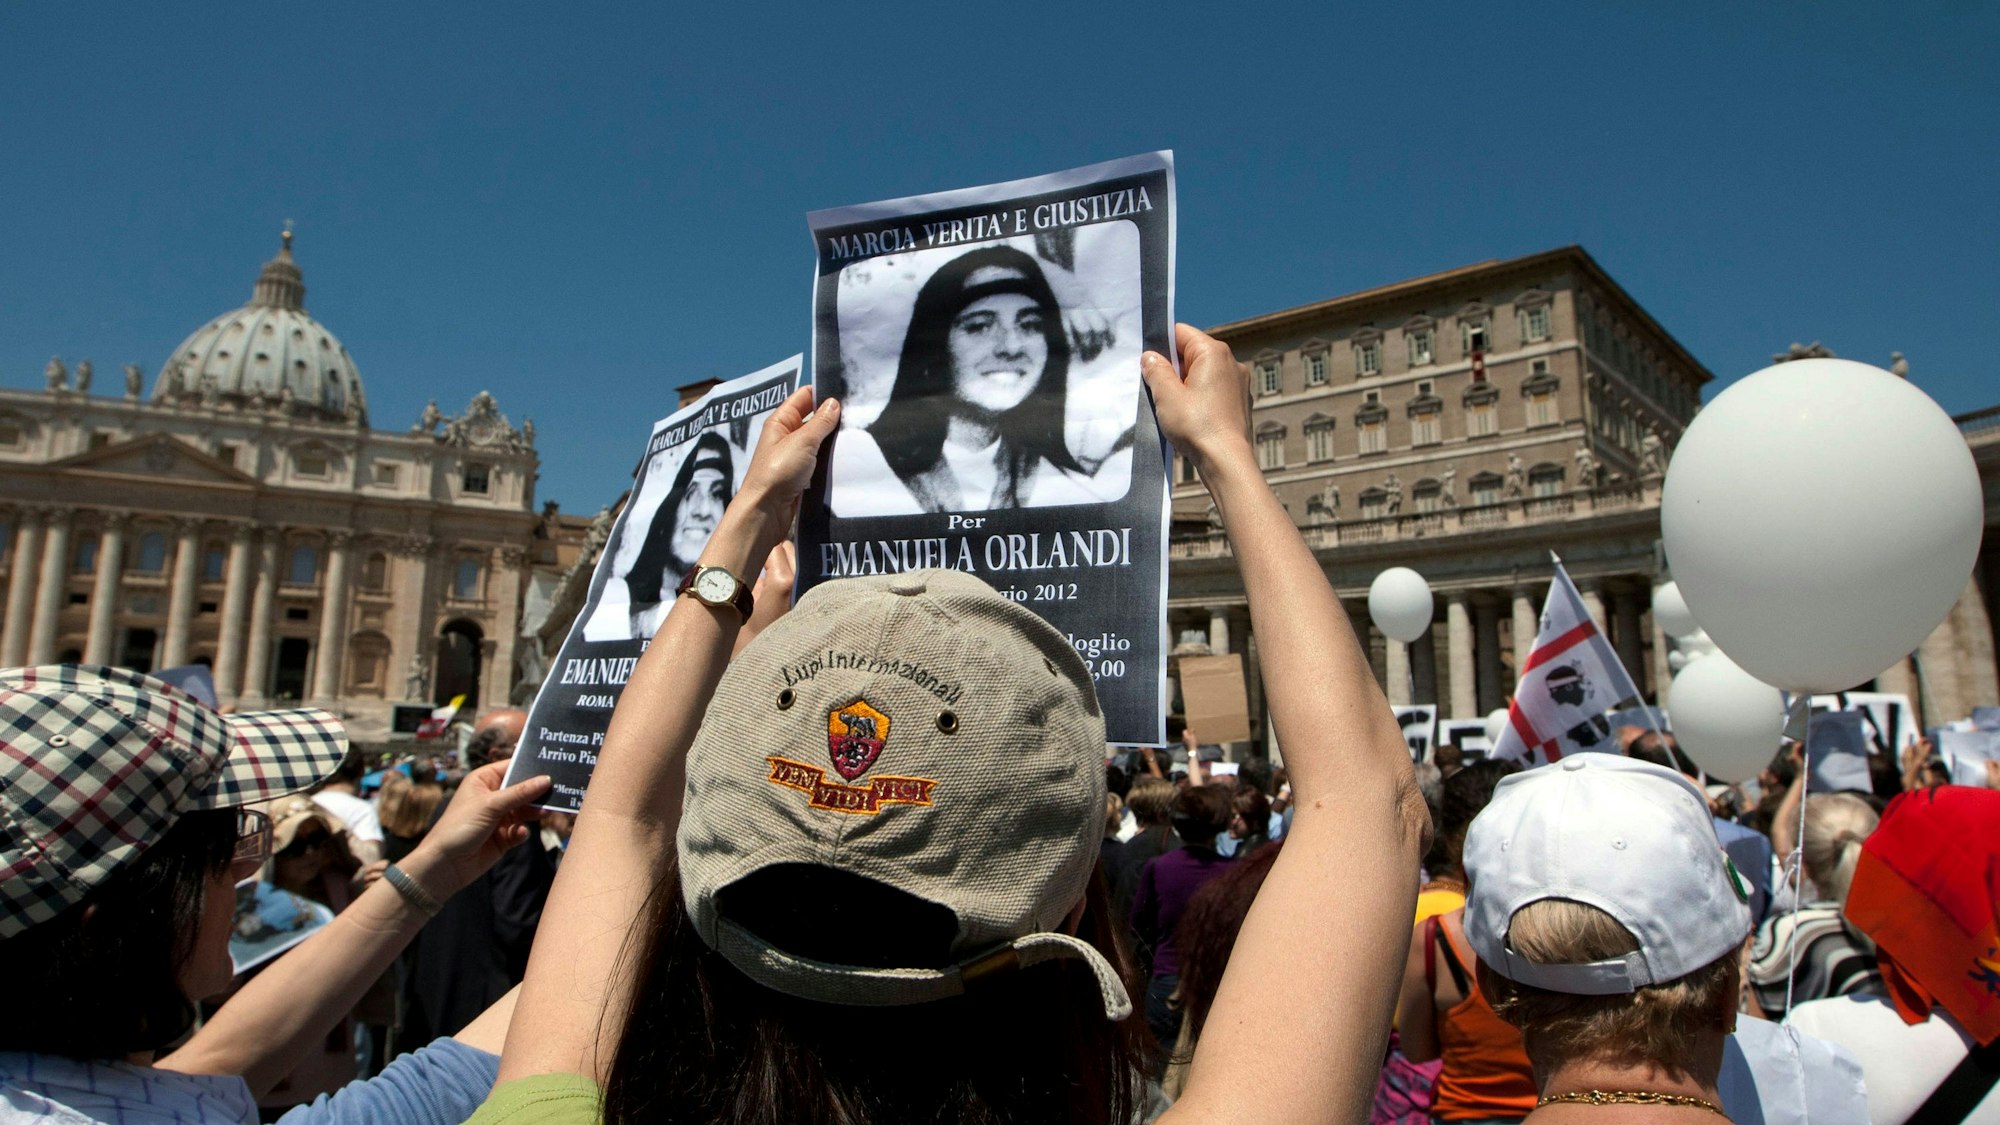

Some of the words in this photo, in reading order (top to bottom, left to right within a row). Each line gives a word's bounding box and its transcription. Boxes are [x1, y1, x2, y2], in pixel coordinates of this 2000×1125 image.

[829, 226, 916, 260] MARCIA
[1015, 209, 1027, 233] E
[1033, 186, 1153, 229] GIUSTIZIA
[719, 402, 730, 422] E
[731, 381, 788, 419] GIUSTIZIA
[948, 514, 986, 530] Per
[819, 536, 976, 577] EMANUELA
[984, 527, 1132, 571] ORLANDI
[1033, 583, 1078, 601] 2012
[782, 655, 824, 687] Lupi
[576, 694, 614, 708] ROMA
[539, 726, 589, 745] Partenza
[537, 746, 576, 762] Arrivo
[778, 763, 819, 791] VENI
[820, 787, 869, 810] VIDI
[872, 780, 922, 800] VICI
